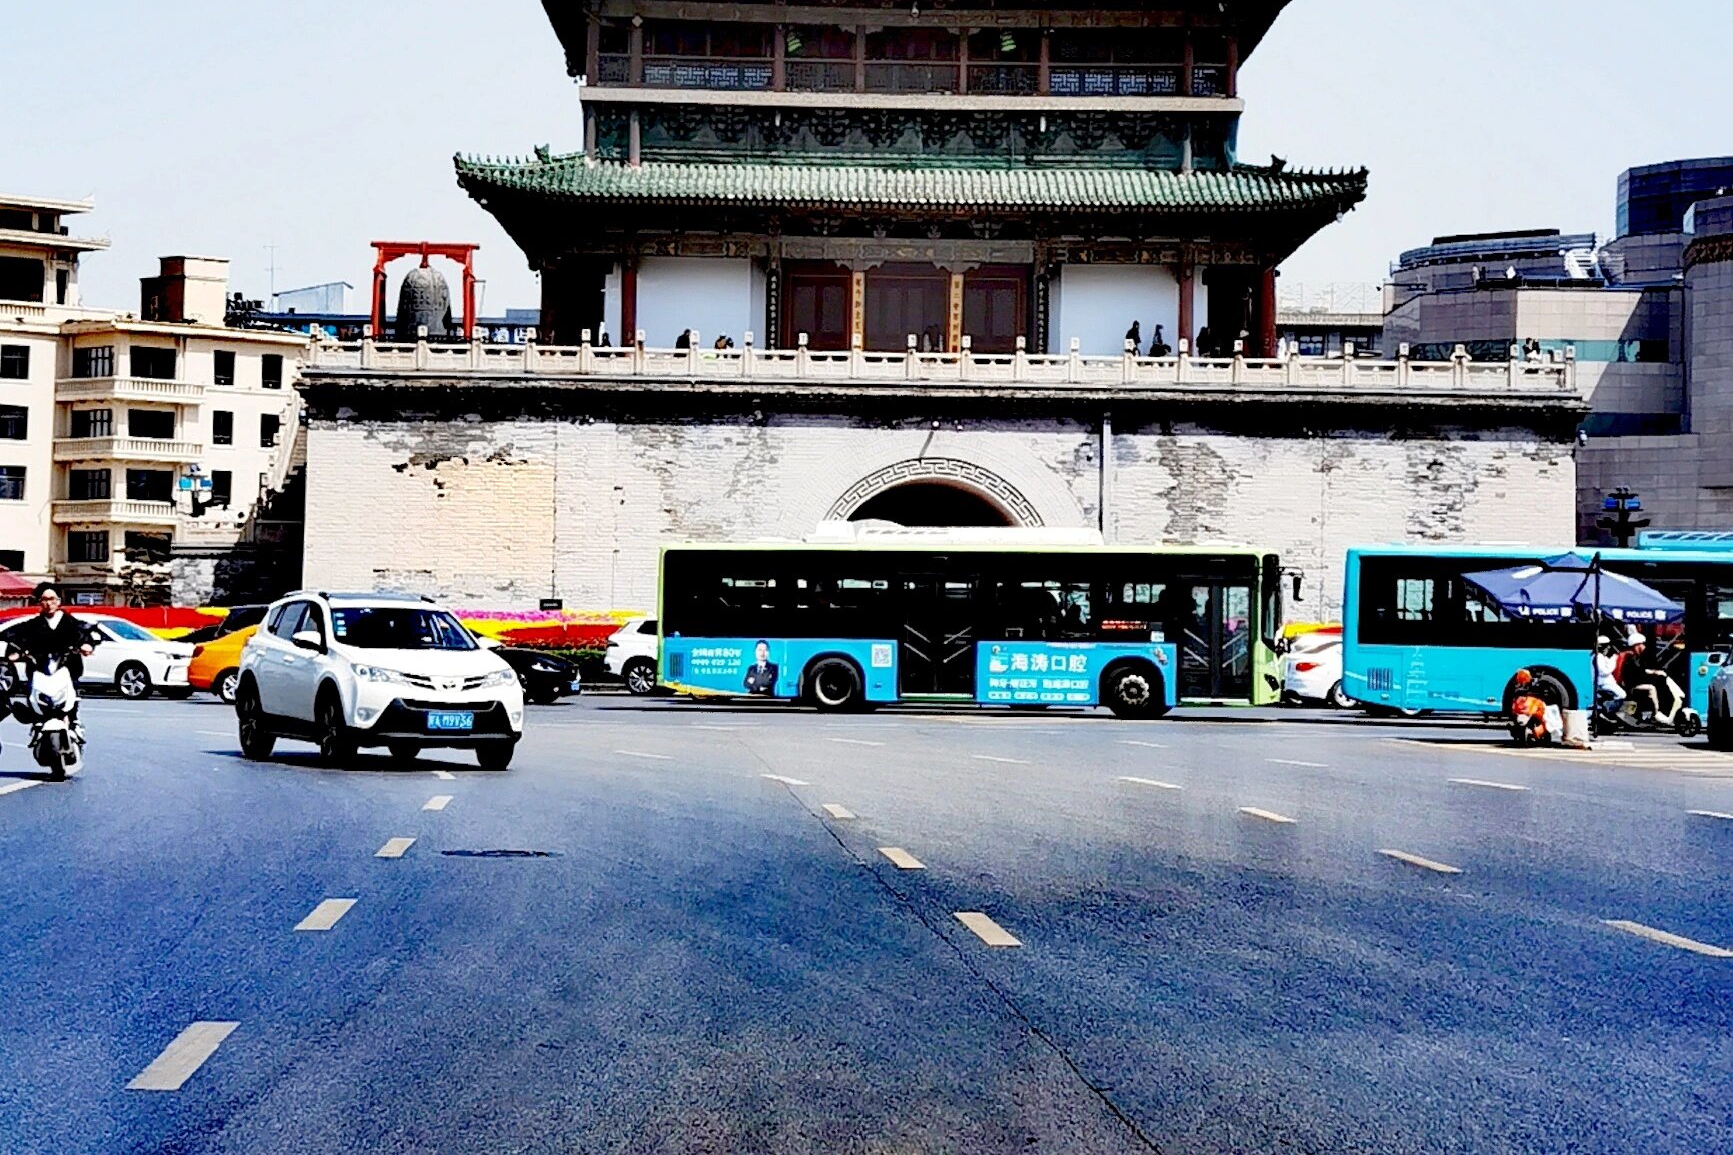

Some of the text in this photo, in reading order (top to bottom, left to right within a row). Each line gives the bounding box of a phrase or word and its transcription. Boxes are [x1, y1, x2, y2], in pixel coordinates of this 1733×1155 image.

[1532, 607, 1560, 616] POLICE
[1626, 610, 1654, 620] POLICE
[1011, 653, 1088, 673] 海涛口腔
